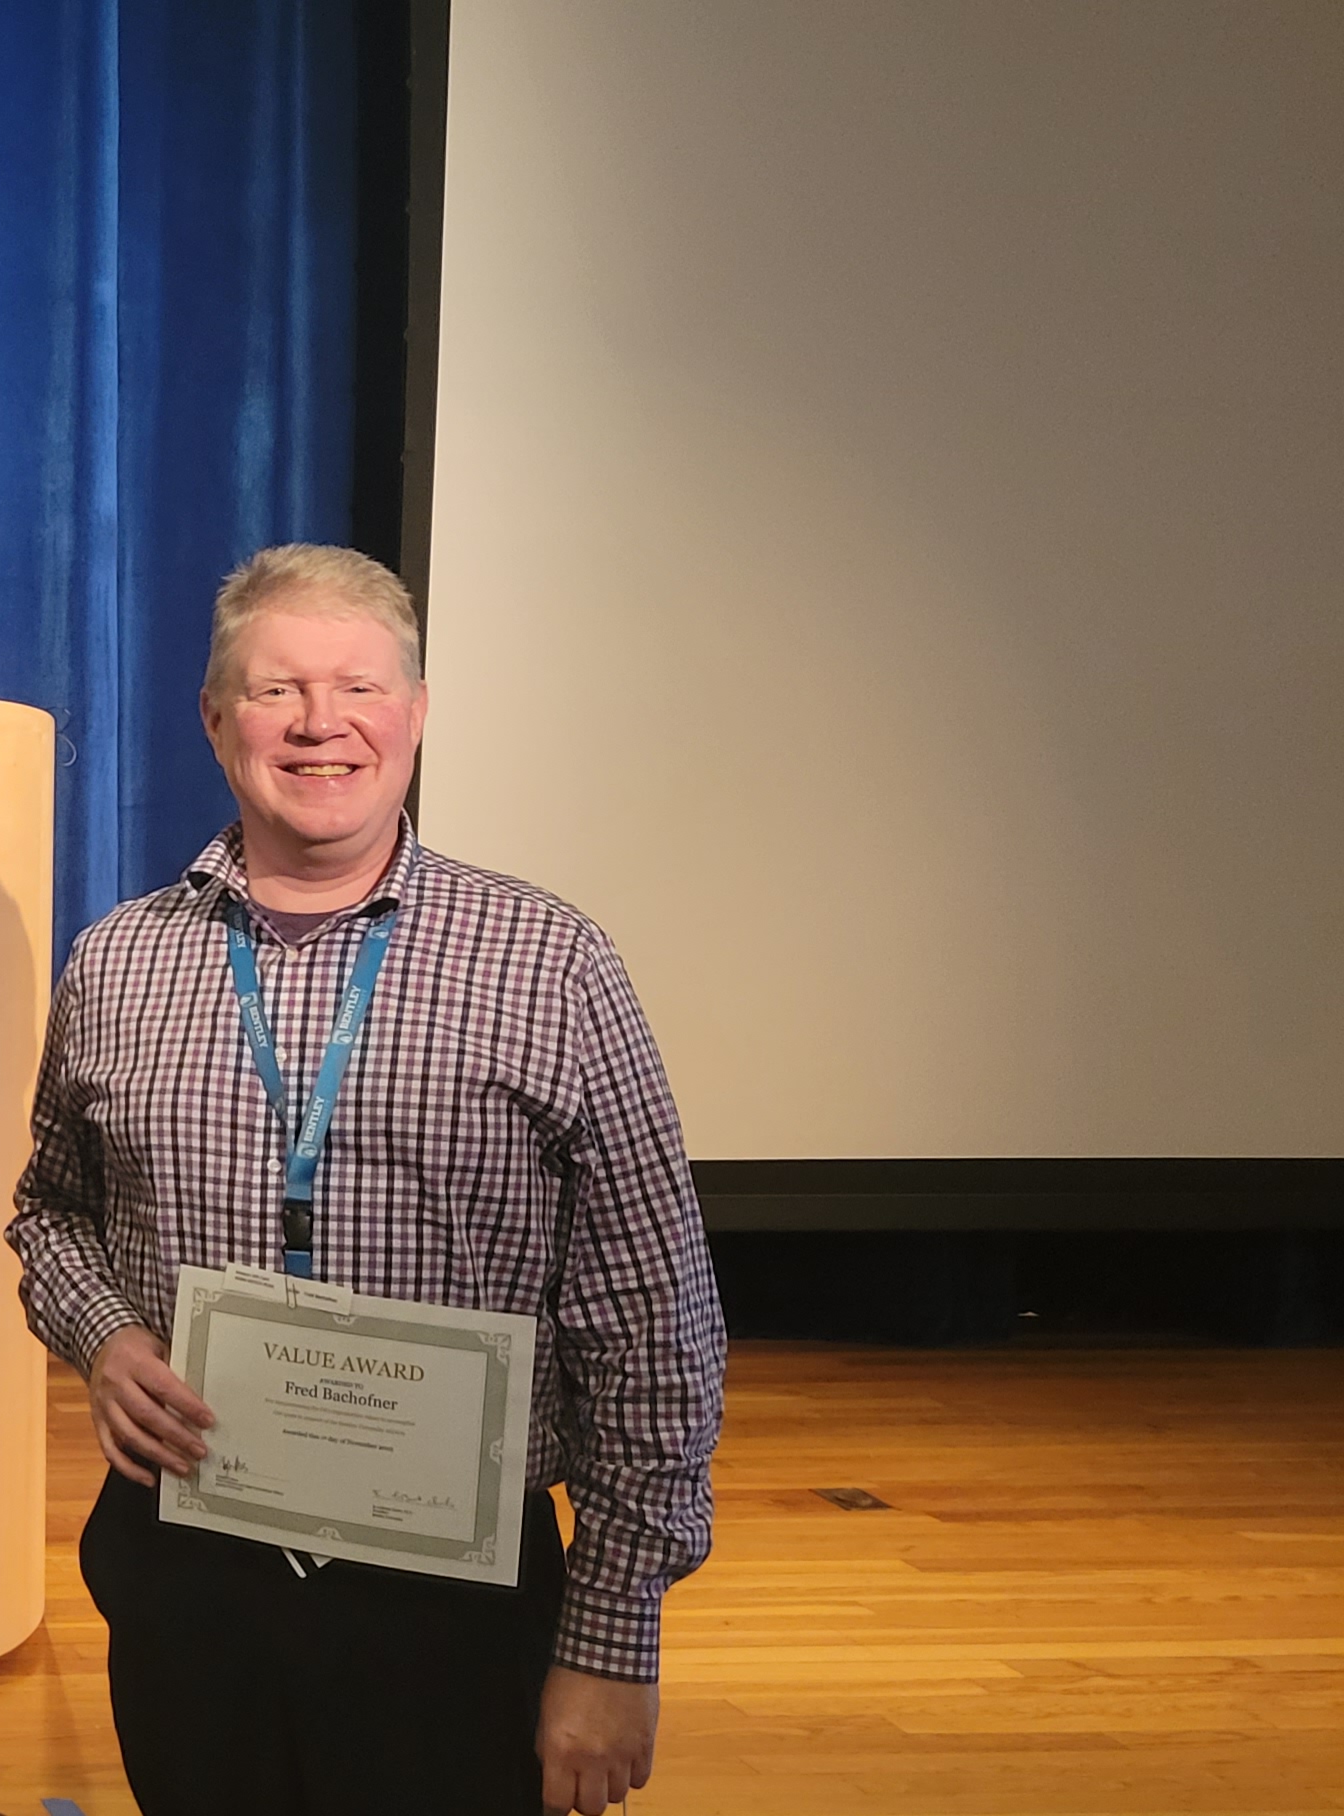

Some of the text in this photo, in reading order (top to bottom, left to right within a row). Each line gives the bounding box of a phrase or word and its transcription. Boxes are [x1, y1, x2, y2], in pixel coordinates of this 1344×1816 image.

[248, 1006, 269, 1048] BENTLEY
[339, 985, 361, 1029] BENTLEY
[303, 1096, 325, 1142] BENTLEY
[263, 1341, 425, 1382] VALUE AWARD
[285, 1381, 399, 1411] Fred Bachofner
